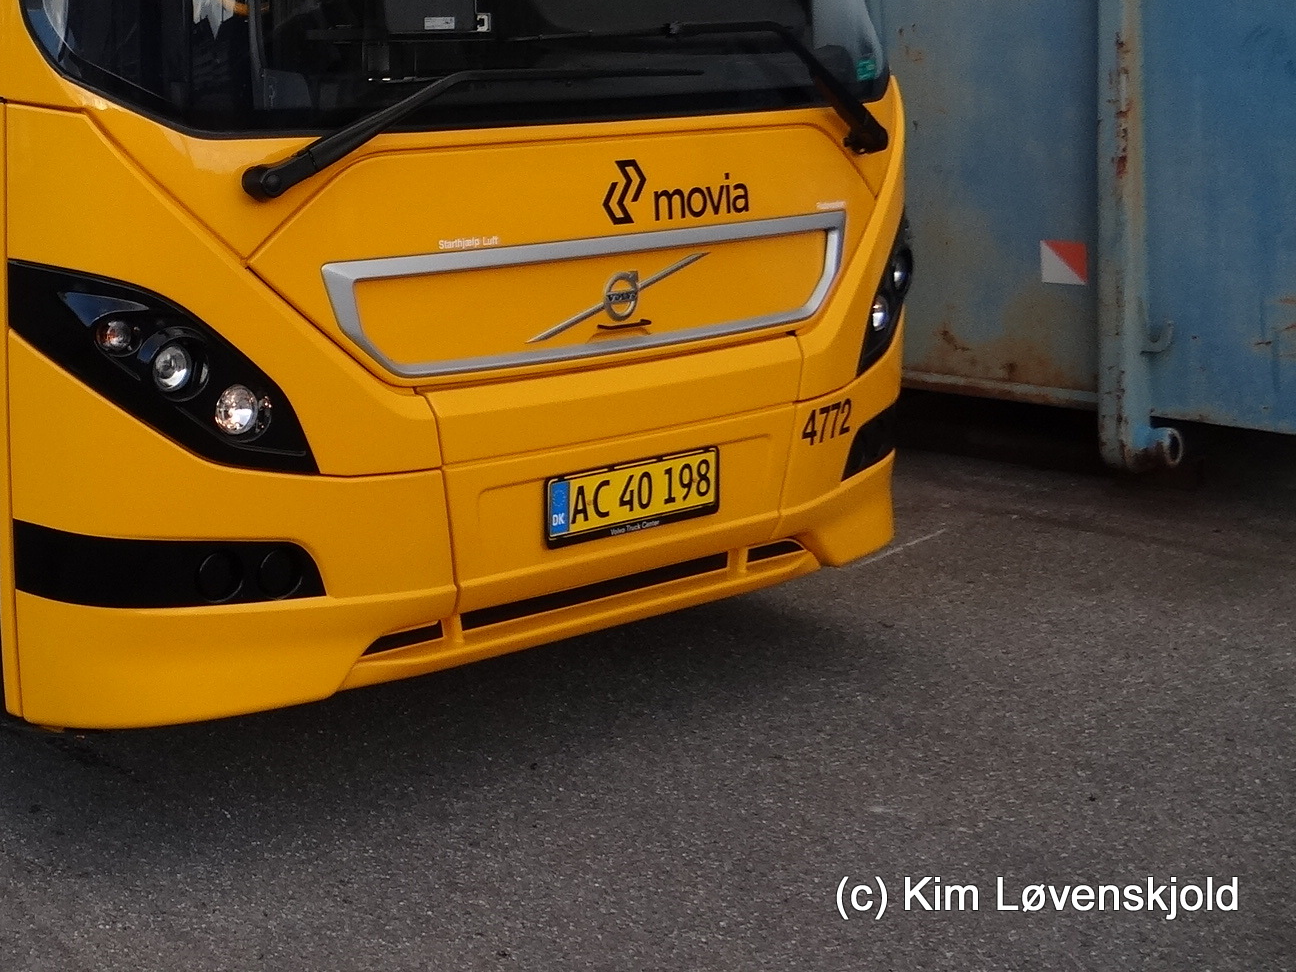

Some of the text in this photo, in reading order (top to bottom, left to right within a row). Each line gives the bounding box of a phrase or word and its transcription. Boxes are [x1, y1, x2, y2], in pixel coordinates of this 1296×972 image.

[653, 172, 749, 222] movia
[482, 235, 499, 246] Luft
[801, 398, 852, 446] 4772
[570, 458, 711, 524] AC 40 198
[552, 514, 565, 526] DK
